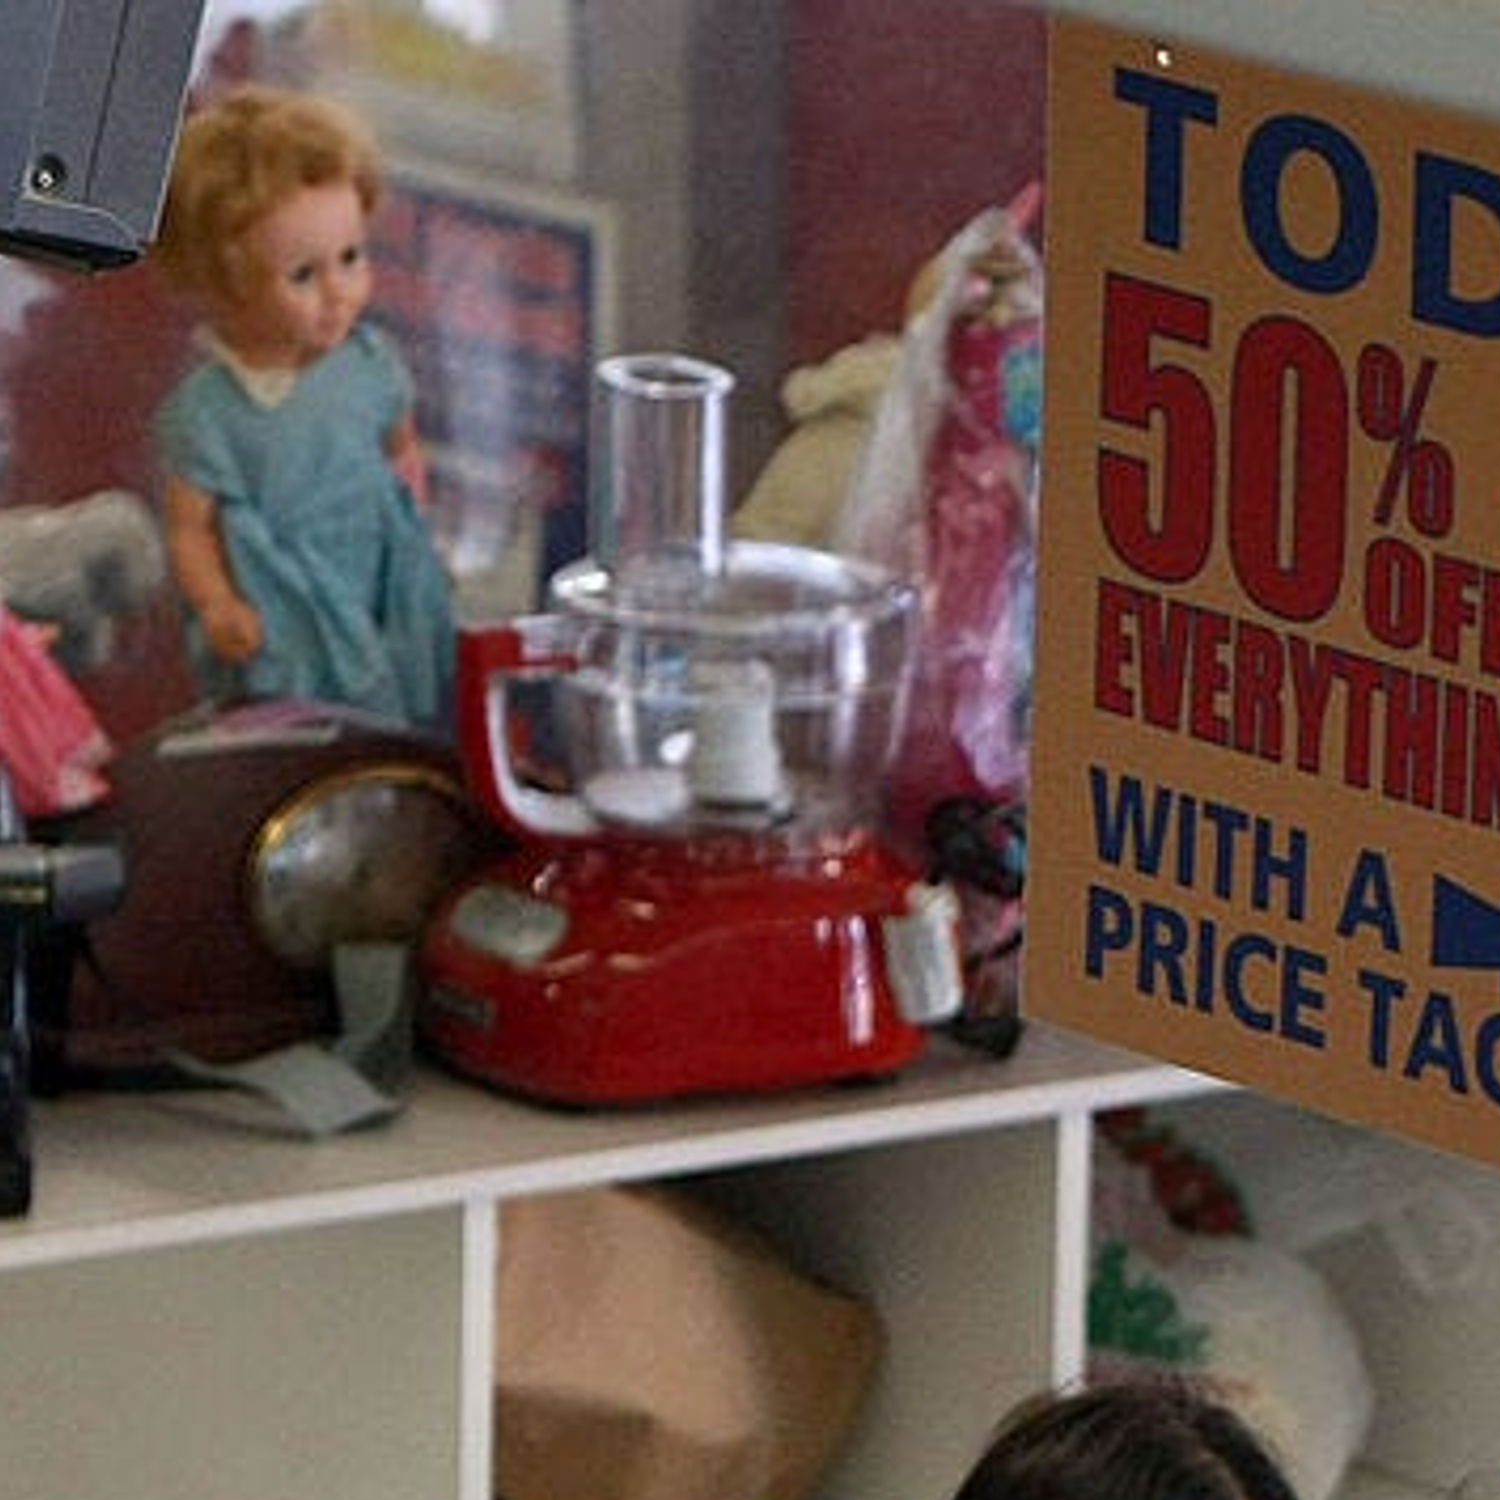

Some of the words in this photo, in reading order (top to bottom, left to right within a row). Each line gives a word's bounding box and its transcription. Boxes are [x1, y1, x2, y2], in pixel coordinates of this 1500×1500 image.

[1090, 764, 1307, 922] WITH
[1336, 848, 1401, 952] A
[1084, 883, 1328, 1048] PRICE
